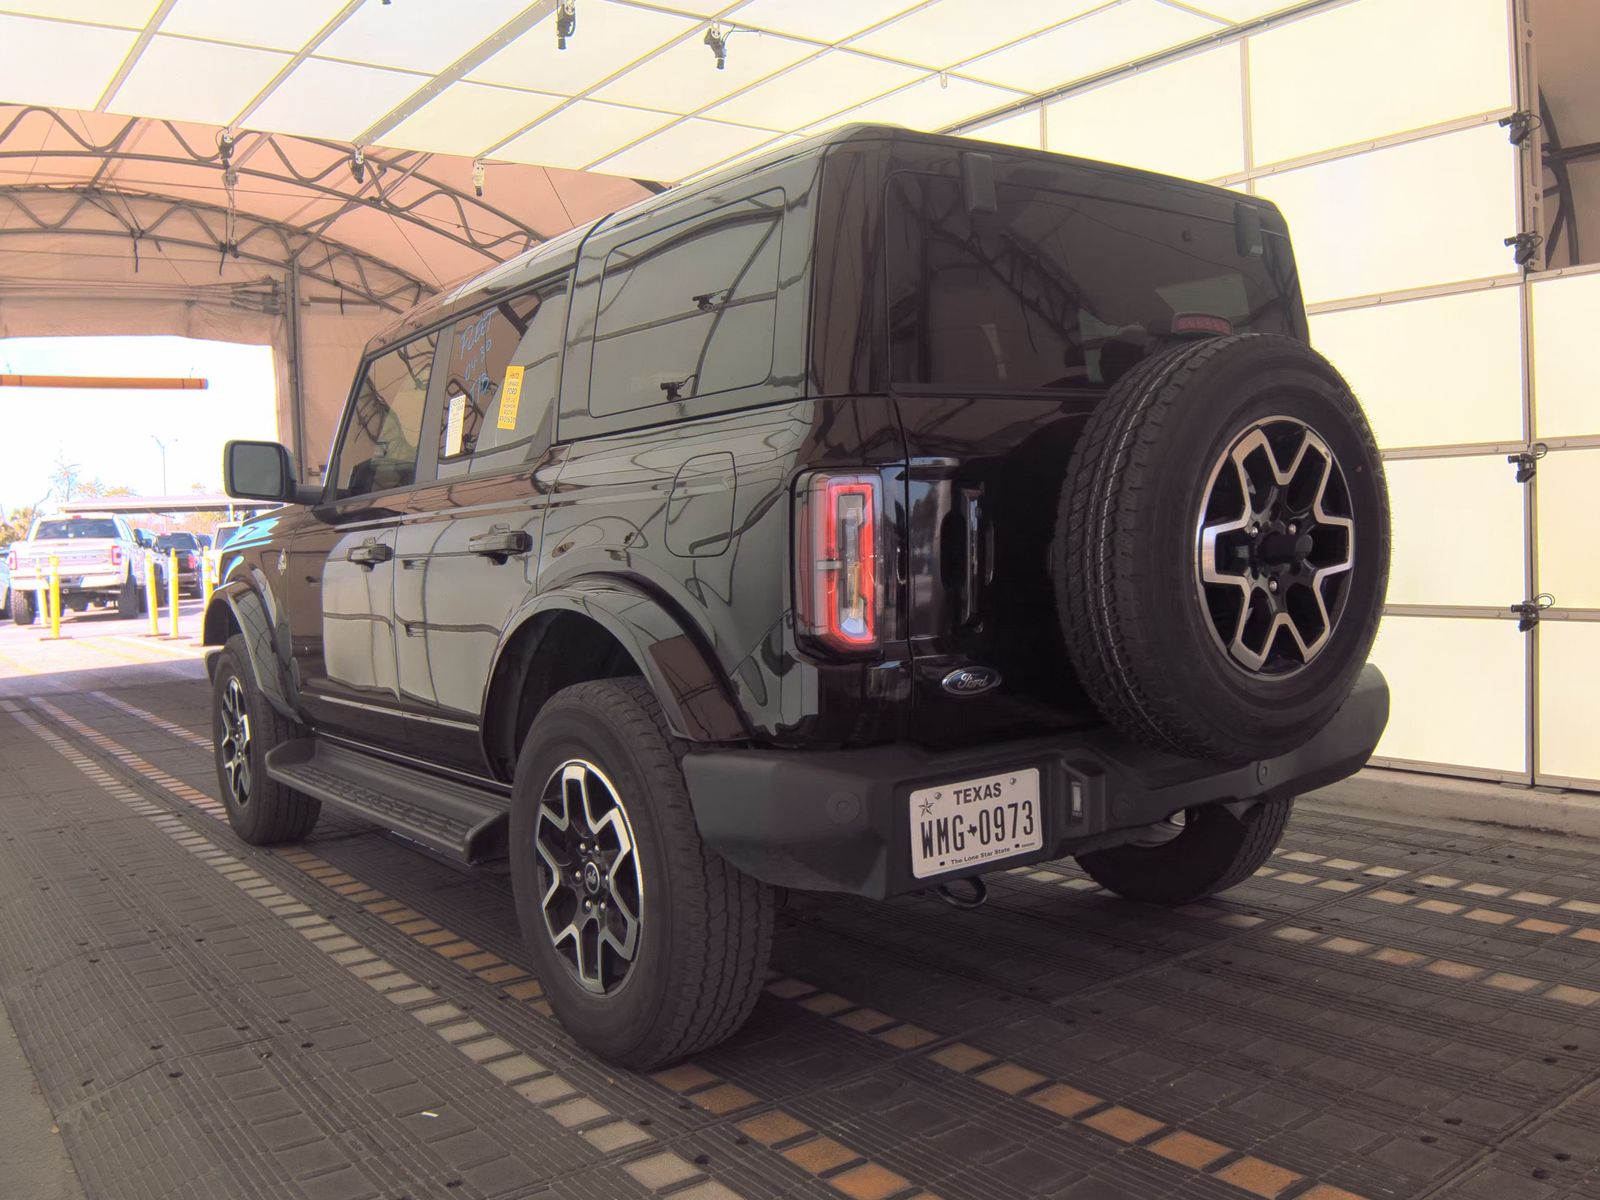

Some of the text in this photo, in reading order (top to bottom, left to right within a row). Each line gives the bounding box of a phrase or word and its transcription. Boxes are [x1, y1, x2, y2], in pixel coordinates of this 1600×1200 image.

[957, 672, 989, 689] Ford
[953, 782, 1002, 805] TEXAS
[964, 853, 980, 862] Lone
[981, 850, 994, 859] Star
[994, 847, 1011, 855] State
